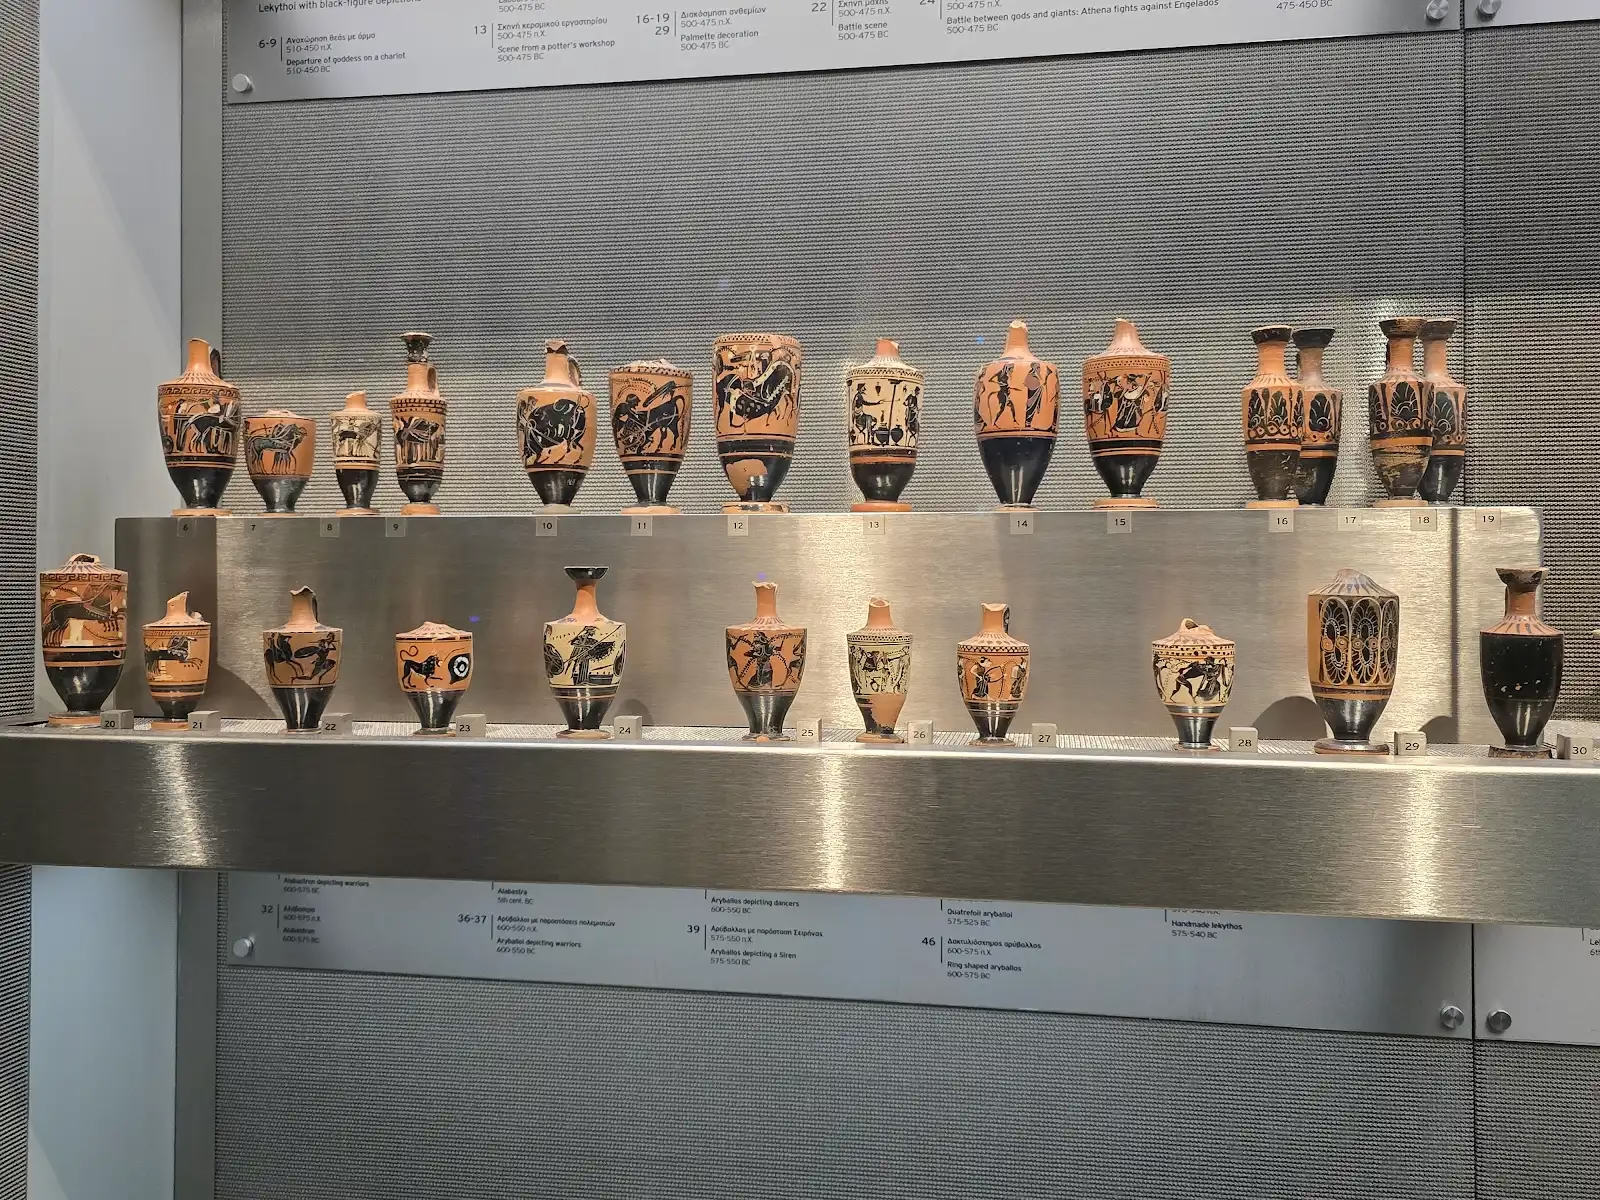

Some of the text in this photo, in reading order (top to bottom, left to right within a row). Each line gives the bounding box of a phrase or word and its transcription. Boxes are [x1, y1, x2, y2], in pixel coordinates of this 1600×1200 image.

[258, 3, 296, 14] Lekythoi
[299, 1, 317, 10] with
[811, 3, 827, 12] 22
[946, 2, 984, 10] 500-475
[1276, 1, 1318, 9] 475-450
[838, 8, 875, 17] 500-475
[946, 15, 971, 24] Battle
[973, 14, 1008, 22] between
[1010, 12, 1030, 21] gods
[1050, 9, 1078, 19] giants:
[1081, 7, 1112, 15] Athena
[1114, 5, 1138, 14] fights
[1140, 2, 1172, 12] against
[1174, 0, 1219, 9] Engelados
[636, 13, 670, 24] 16-19
[681, 19, 716, 28] 500-475
[838, 23, 862, 31] Battle
[474, 25, 487, 34] 13
[655, 26, 669, 35] 29
[946, 25, 984, 34] 500-475
[347, 34, 357, 42] με
[497, 31, 532, 40] 500-475
[681, 30, 759, 41] Palmette decoration
[838, 30, 889, 40] 500-475 BC
[258, 39, 277, 48] 6-9
[497, 45, 519, 54] Scene
[522, 44, 539, 52] from
[547, 42, 577, 51] potter's
[578, 40, 615, 48] workshop
[681, 42, 716, 51] 500-475
[286, 45, 319, 53] 510-450
[286, 57, 322, 66] Departure
[332, 54, 362, 64] goddess
[380, 52, 405, 60] chariot
[497, 54, 532, 62] 500-475
[286, 67, 319, 75] 510-450
[1115, 518, 1126, 526] 15
[1277, 517, 1288, 525] 16
[1345, 516, 1356, 524] 17
[1418, 516, 1430, 524] 18
[1483, 515, 1495, 523] 19
[543, 522, 552, 530] 10
[638, 522, 646, 530] 11
[734, 522, 743, 530] 12
[870, 521, 879, 529] 13
[1017, 520, 1028, 528] 14
[105, 720, 115, 728] 20
[192, 721, 202, 729] 21
[325, 723, 336, 731] 22
[459, 724, 471, 732] 23
[619, 726, 631, 735] 24
[801, 729, 814, 737] 25
[913, 730, 926, 739] 26
[1038, 734, 1051, 743] 27
[1238, 738, 1252, 747] 28
[1405, 742, 1419, 751] 29
[1572, 746, 1587, 755] 30
[317, 879, 343, 887] depicting
[497, 887, 528, 895] Alabastra
[711, 896, 799, 907] Aryballos depicting dancers
[261, 905, 274, 914] 32
[947, 908, 1013, 919] Quatrefoil aryballoi
[457, 913, 487, 924] 36-37
[947, 918, 979, 926] 575-525
[497, 924, 526, 932] 600-550
[687, 925, 700, 934] 39
[1171, 920, 1243, 930] Handmade lekythos
[710, 934, 741, 942] 575-550
[1171, 929, 1206, 938] 575-540
[497, 938, 581, 948] Aryballoi depicting warriors
[921, 937, 936, 946] 46
[496, 946, 526, 954] 600-550
[711, 948, 741, 957] Aryballos
[742, 949, 772, 958] depicting
[947, 947, 979, 955] 600-575
[710, 957, 741, 965] 575-550
[947, 961, 1022, 972] Ring shaped aryballos
[947, 971, 979, 979] 600-575
